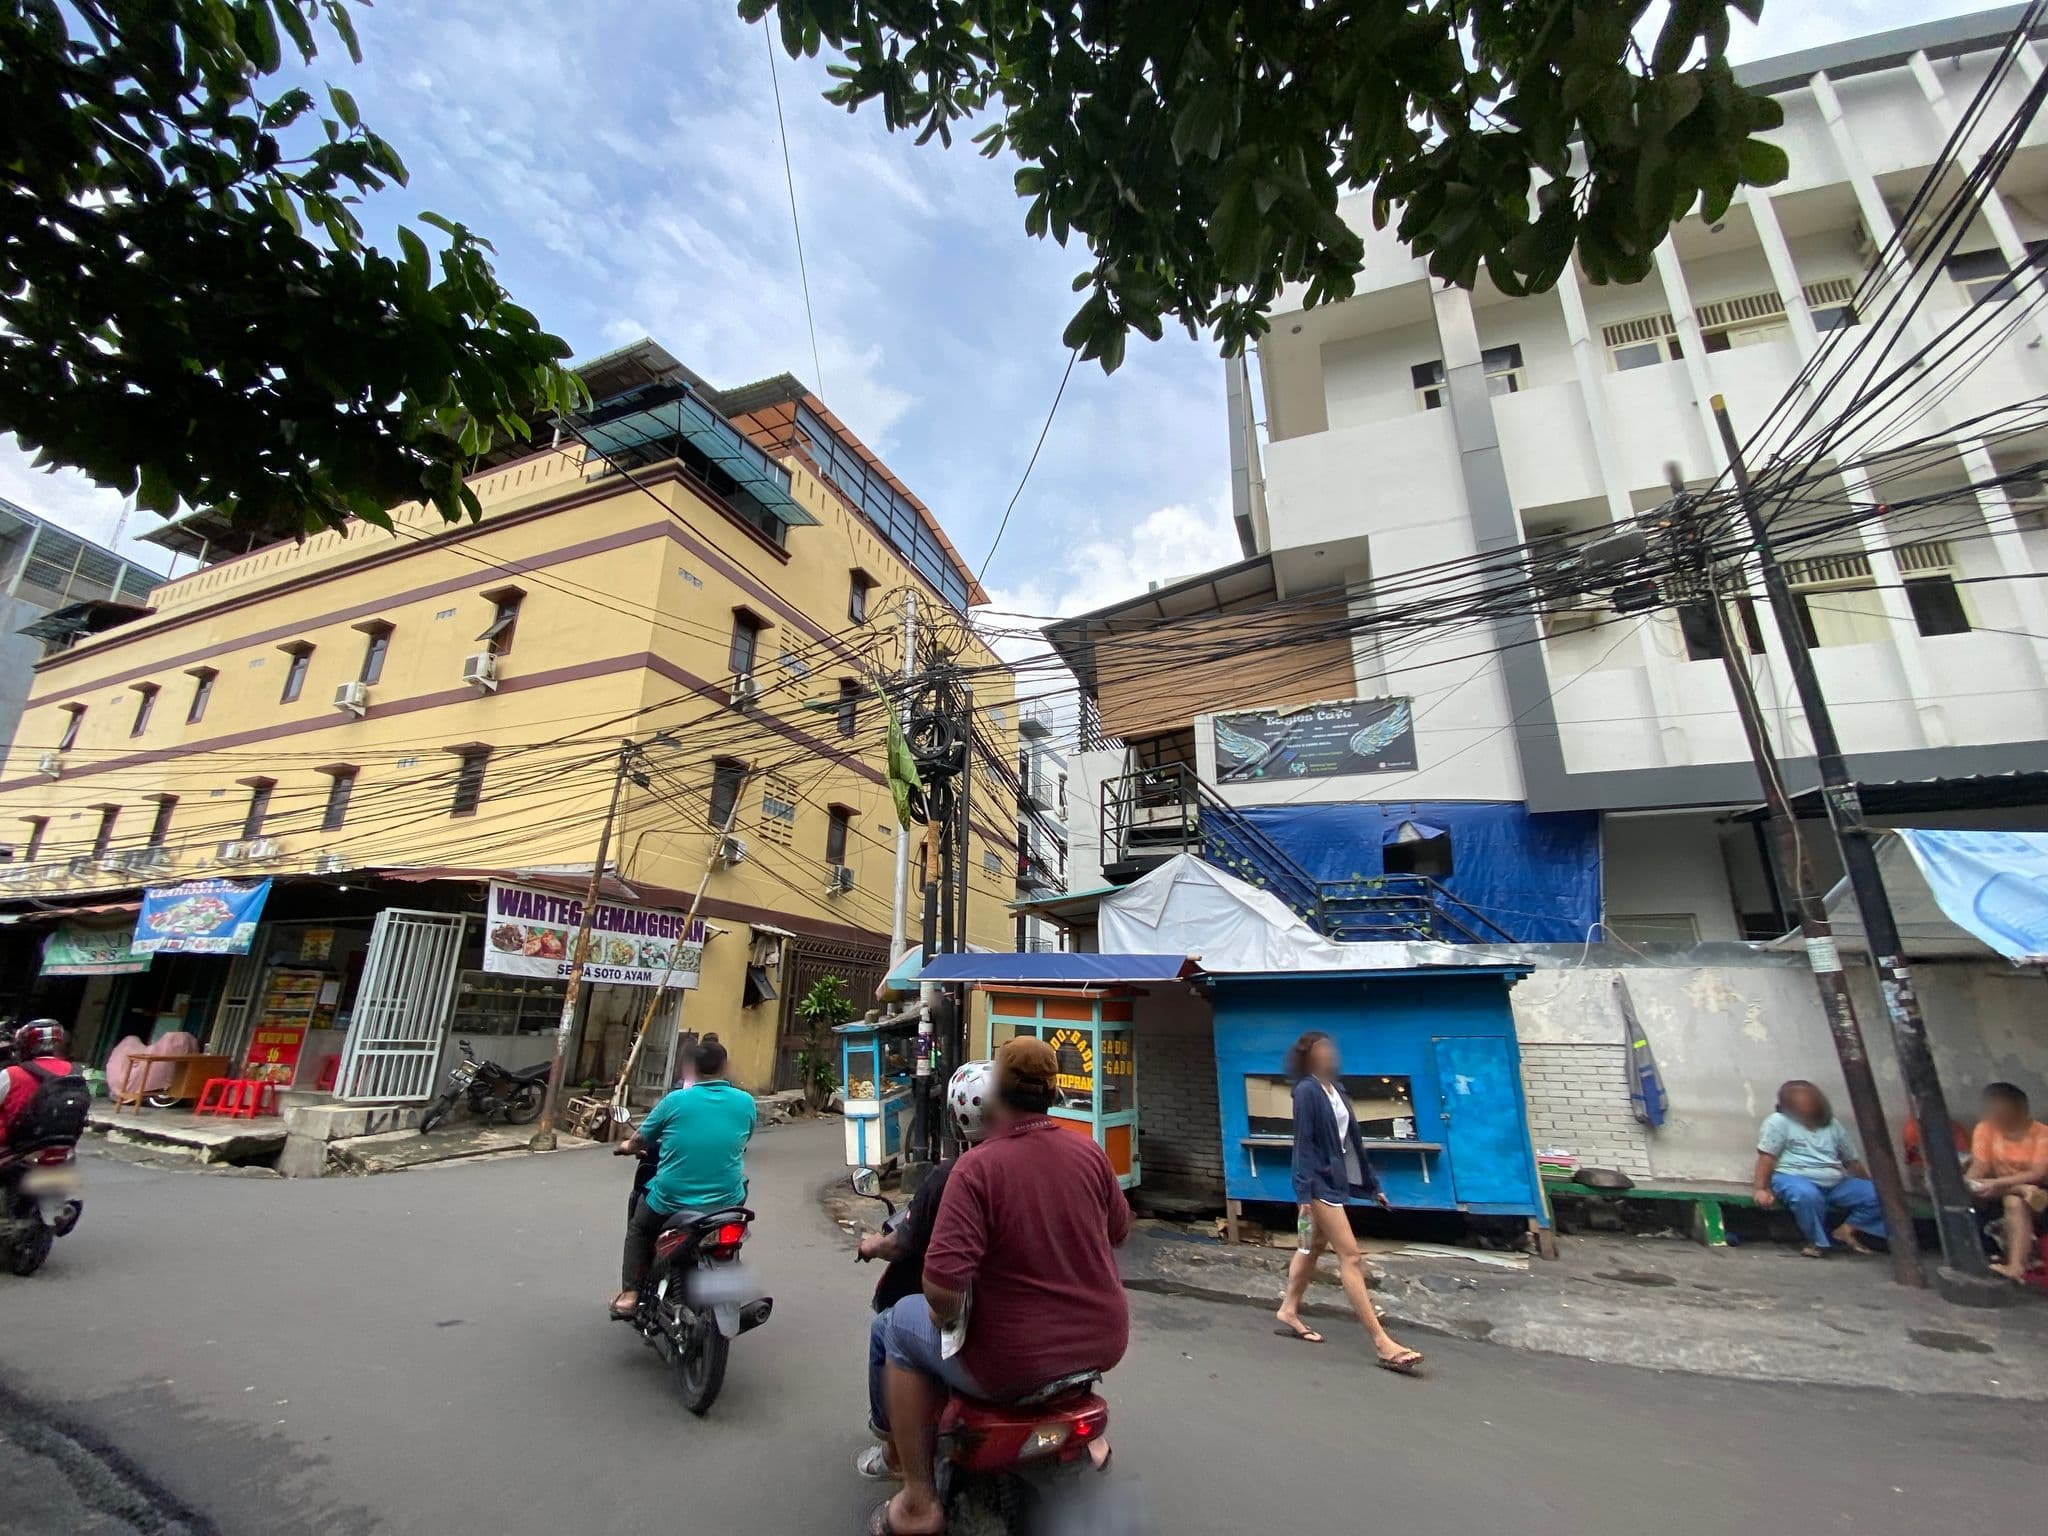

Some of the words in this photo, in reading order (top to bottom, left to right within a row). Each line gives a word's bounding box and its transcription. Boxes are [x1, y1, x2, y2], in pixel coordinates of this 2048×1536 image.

[497, 887, 584, 927] WARTEG
[557, 964, 591, 977] SEIA
[594, 967, 622, 980] SOTO
[624, 970, 652, 982] AYAM
[1101, 1040, 1128, 1055] GADO
